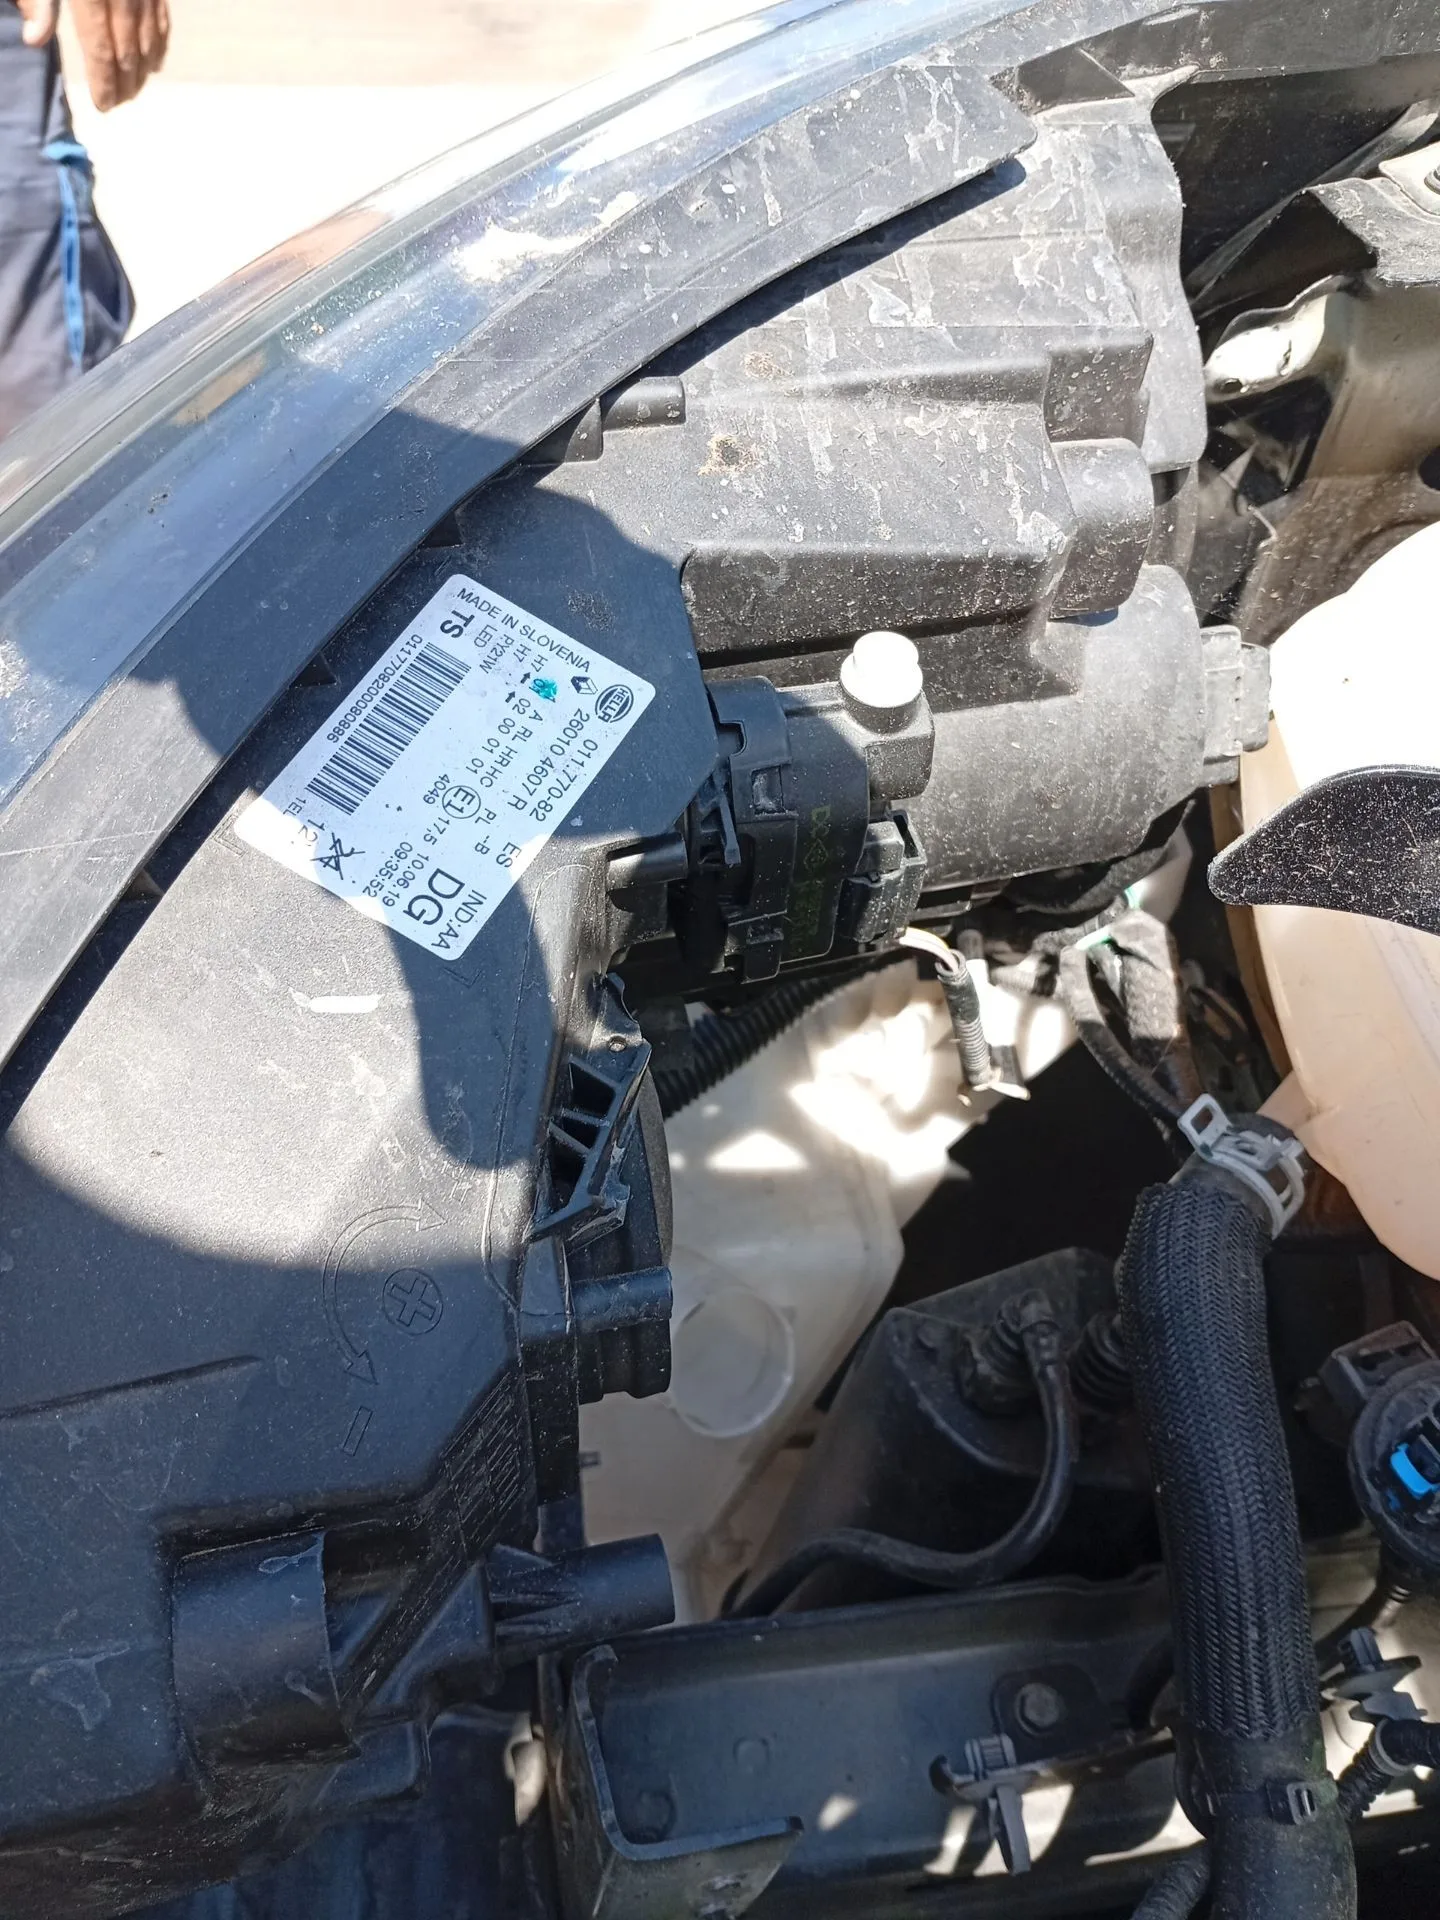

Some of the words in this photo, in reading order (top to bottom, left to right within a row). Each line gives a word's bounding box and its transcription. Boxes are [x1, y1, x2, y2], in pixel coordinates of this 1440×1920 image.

[439, 609, 476, 639] TS
[456, 587, 503, 620] MADE
[500, 613, 520, 630] IN
[519, 624, 591, 673] SLOVENIA
[473, 623, 499, 648] LED
[478, 633, 515, 675] PY21W
[512, 643, 532, 663] H7
[530, 653, 549, 673] H7
[326, 633, 424, 744] 0117708200080886
[511, 697, 532, 715] 02
[528, 709, 544, 722] A
[597, 687, 629, 724] HELLA
[497, 717, 516, 735] 00
[511, 725, 534, 743] RL
[549, 707, 591, 757] 26010
[481, 737, 501, 755] 01
[493, 745, 519, 768] HR
[465, 757, 485, 775] 01
[479, 765, 503, 788] HC
[521, 756, 555, 797] 4607
[528, 738, 599, 822] 011.770-82
[422, 773, 451, 805] 4049
[506, 794, 528, 811] R
[474, 807, 497, 825] PL
[423, 816, 450, 846] 17,5
[361, 841, 414, 898] 09:35:52
[495, 841, 522, 869] ES
[381, 852, 430, 908] 10.06.19
[402, 867, 466, 926] DG
[430, 889, 488, 950] IND:AA
